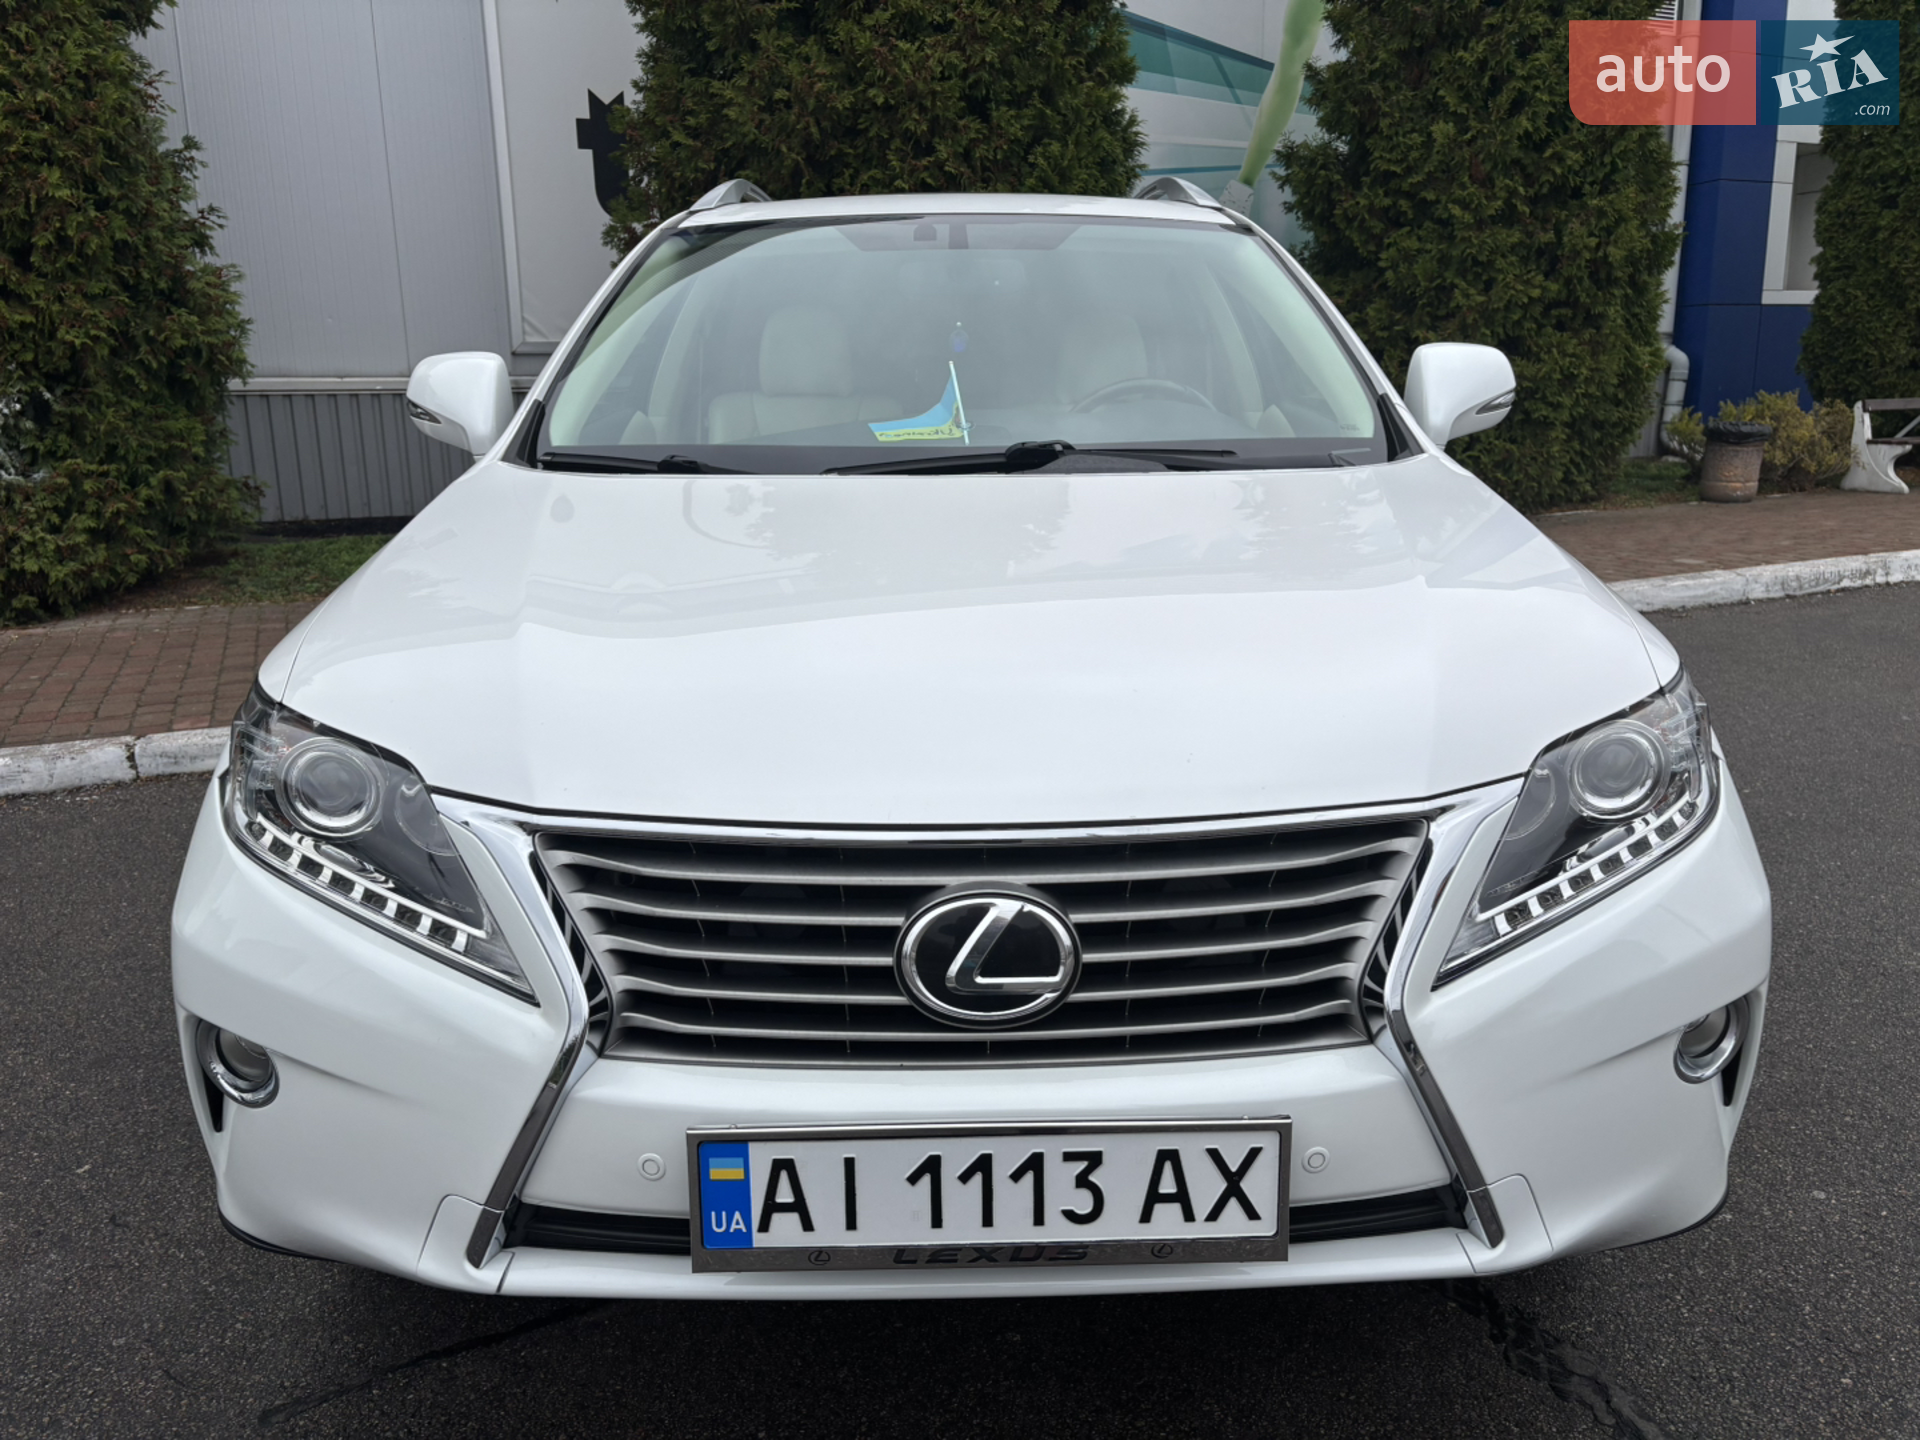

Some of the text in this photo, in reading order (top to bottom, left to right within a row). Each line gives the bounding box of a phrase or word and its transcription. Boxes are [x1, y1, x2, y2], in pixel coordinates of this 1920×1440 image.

[757, 1145, 1264, 1233] AI 1113 AX
[710, 1210, 748, 1233] UA
[892, 1244, 1090, 1265] LEXUS
